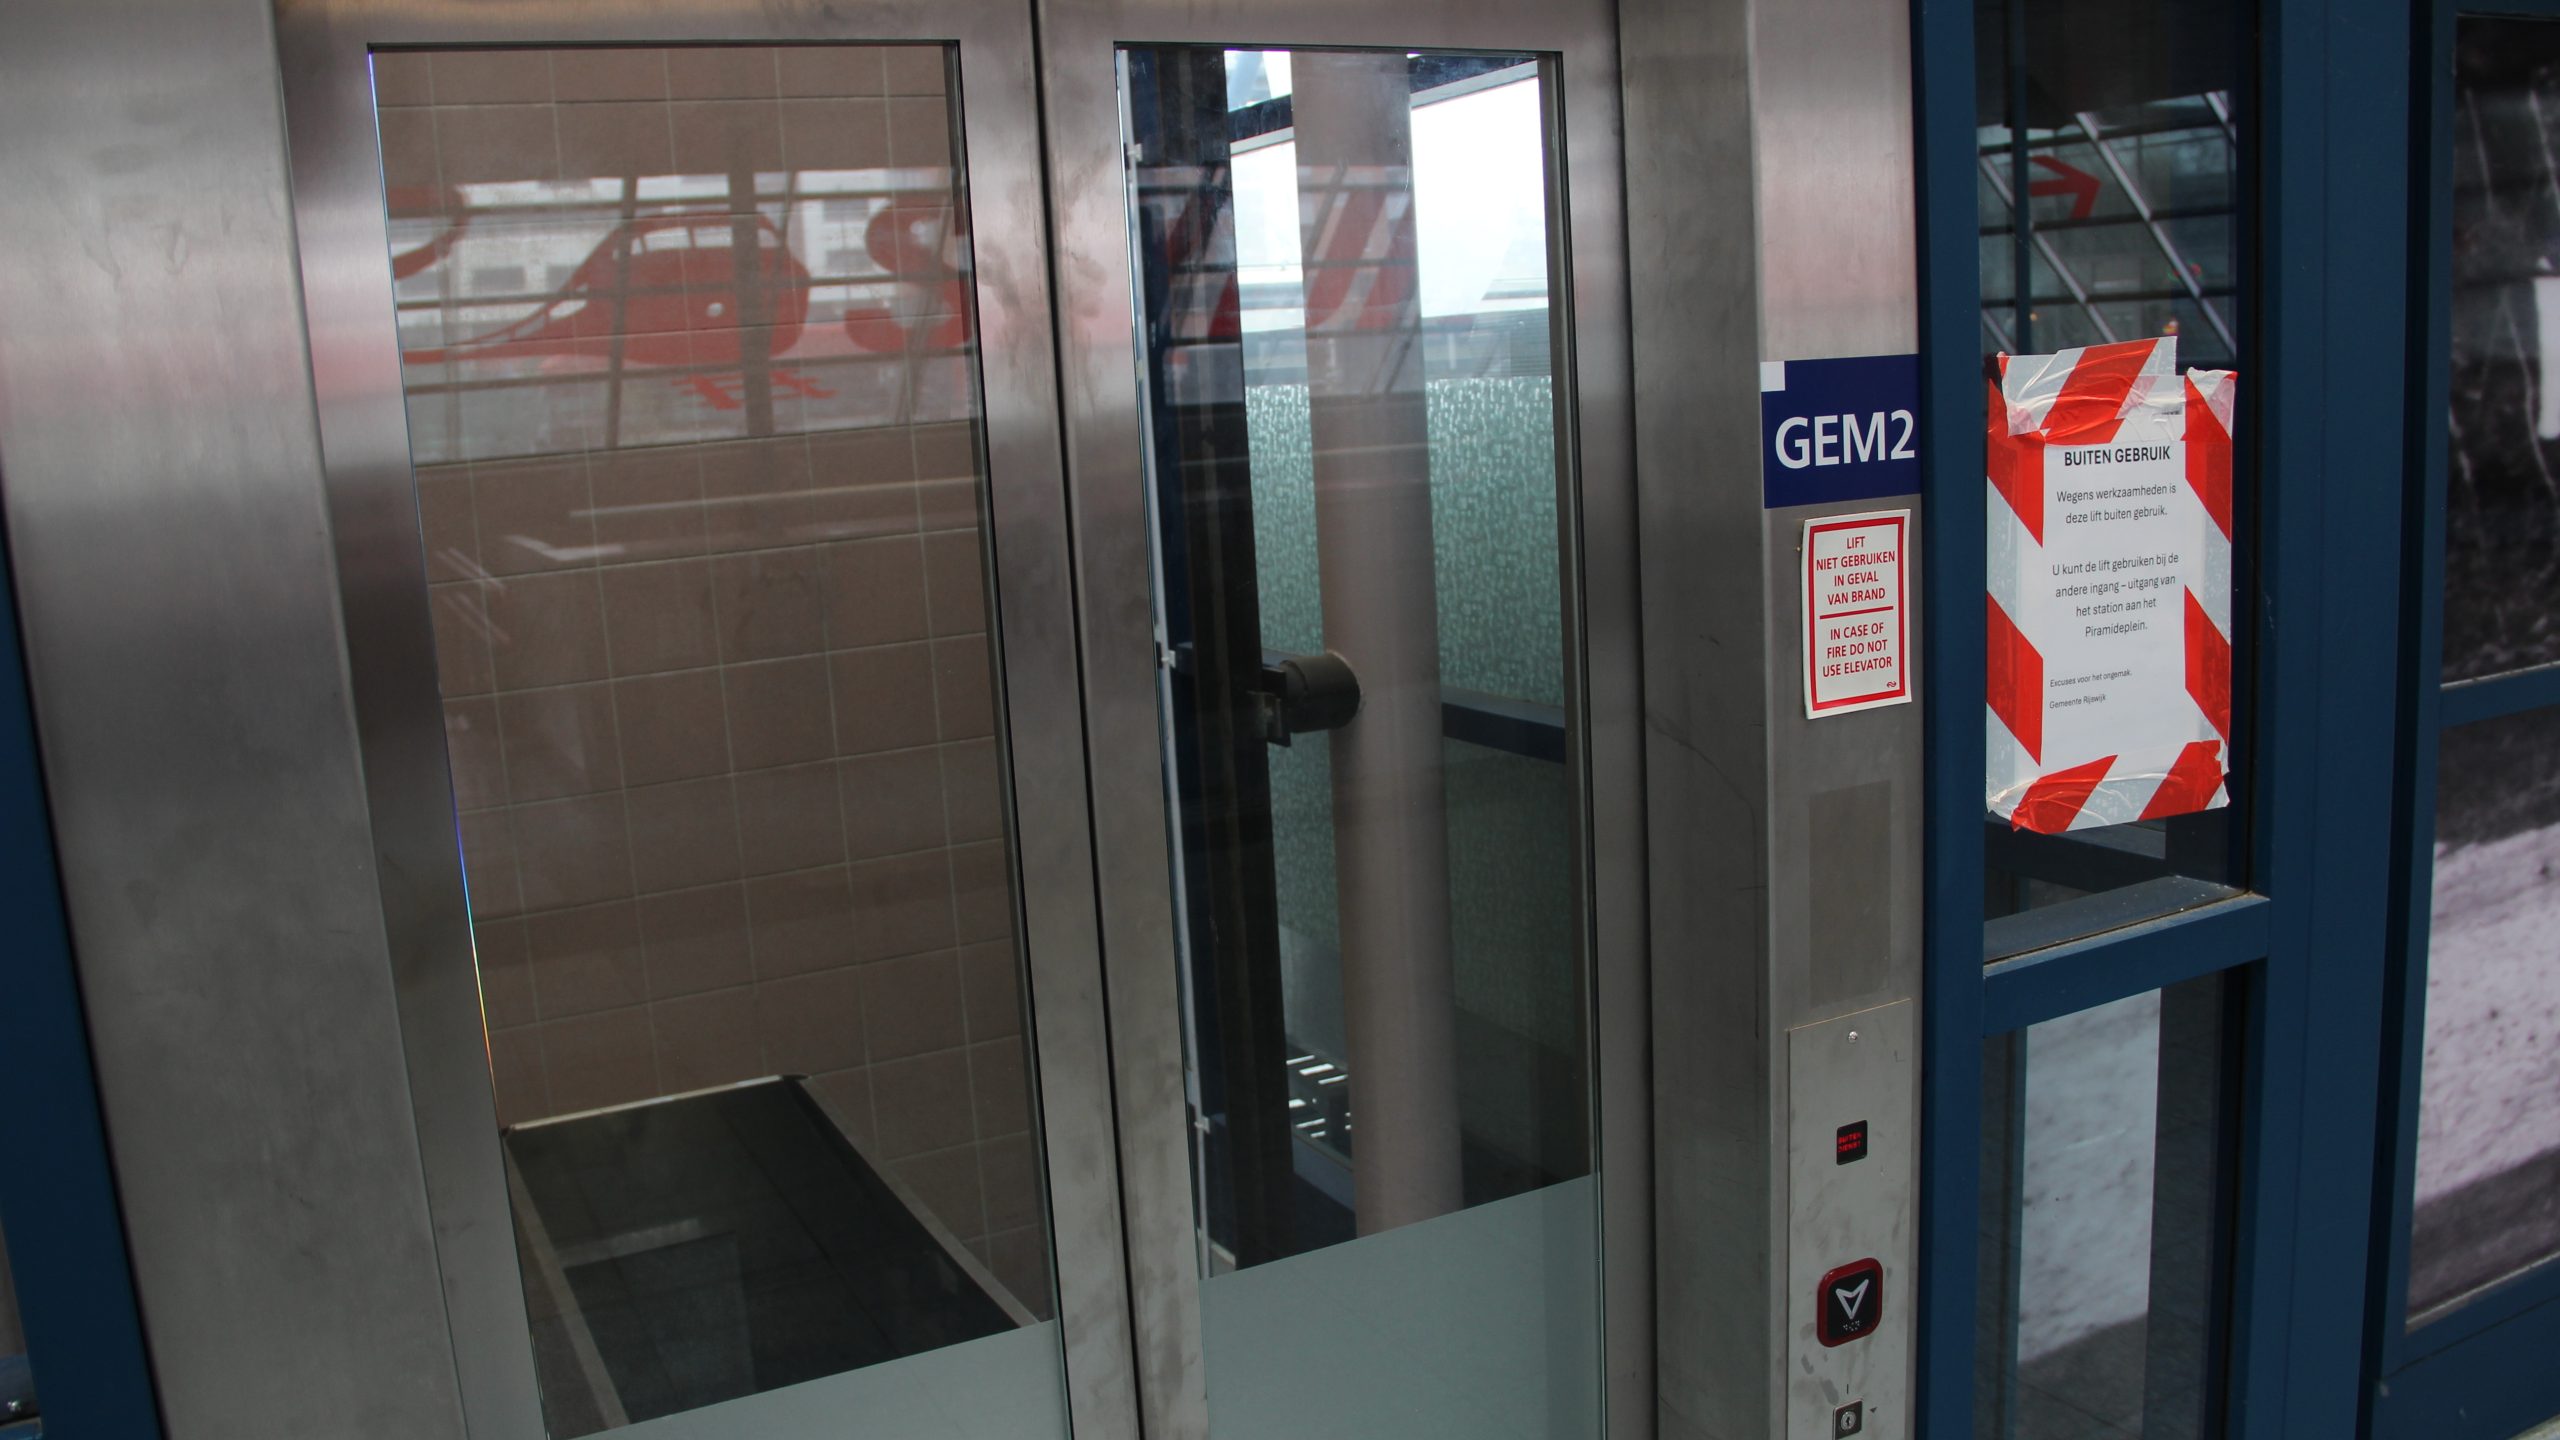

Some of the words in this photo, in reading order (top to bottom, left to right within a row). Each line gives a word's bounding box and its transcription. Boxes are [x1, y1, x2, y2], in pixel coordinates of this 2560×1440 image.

[1775, 409, 1915, 469] GEM2
[2064, 449, 2111, 466] BUITEN
[2115, 445, 2171, 463] GEBRUIK
[2056, 489, 2094, 504] Wegens
[2096, 483, 2167, 500] werkzaamheden
[2169, 483, 2176, 494] is
[2065, 511, 2088, 524] deze
[2090, 510, 2102, 522] lift
[2104, 507, 2131, 521] buiten
[2133, 505, 2168, 520] gebruik.
[1846, 536, 1865, 549] LIFT
[1816, 557, 1838, 571] NIET
[1841, 551, 1895, 568] GEBRUIKEN
[2052, 564, 2060, 576] U
[2062, 562, 2083, 575] kunt
[2085, 561, 2096, 573] de
[2098, 559, 2111, 571] lift
[2112, 555, 2154, 573] gebruiken
[2156, 553, 2166, 566] bij
[2168, 552, 2179, 564] de
[1834, 574, 1844, 587] IN
[1847, 571, 1879, 585] GEVAL
[2055, 584, 2088, 598] andere
[2090, 581, 2119, 595] ingang
[2128, 576, 2159, 590] uitgang
[2160, 575, 2176, 586] van
[1827, 592, 1849, 606] VAN
[1851, 587, 1886, 603] BRAND
[2076, 605, 2091, 617] het
[2093, 602, 2123, 615] station
[2125, 599, 2141, 611] aan
[2143, 597, 2157, 609] het
[1830, 628, 1840, 640] IN
[1843, 623, 1868, 639] CASE
[1871, 622, 1884, 634] OF
[2085, 620, 2148, 638] Piramideplein.
[1827, 645, 1847, 659] FIRE
[1849, 642, 1864, 656] DO
[1867, 639, 1888, 653] NOT
[1822, 663, 1841, 677] USE
[1844, 656, 1892, 674] ELEVATOR
[2050, 678, 2077, 688] Excuses
[2077, 675, 2091, 683] voor
[2092, 673, 2103, 681] het
[2049, 697, 2082, 709] Gemeente
[2083, 693, 2106, 704] Rijswijk
